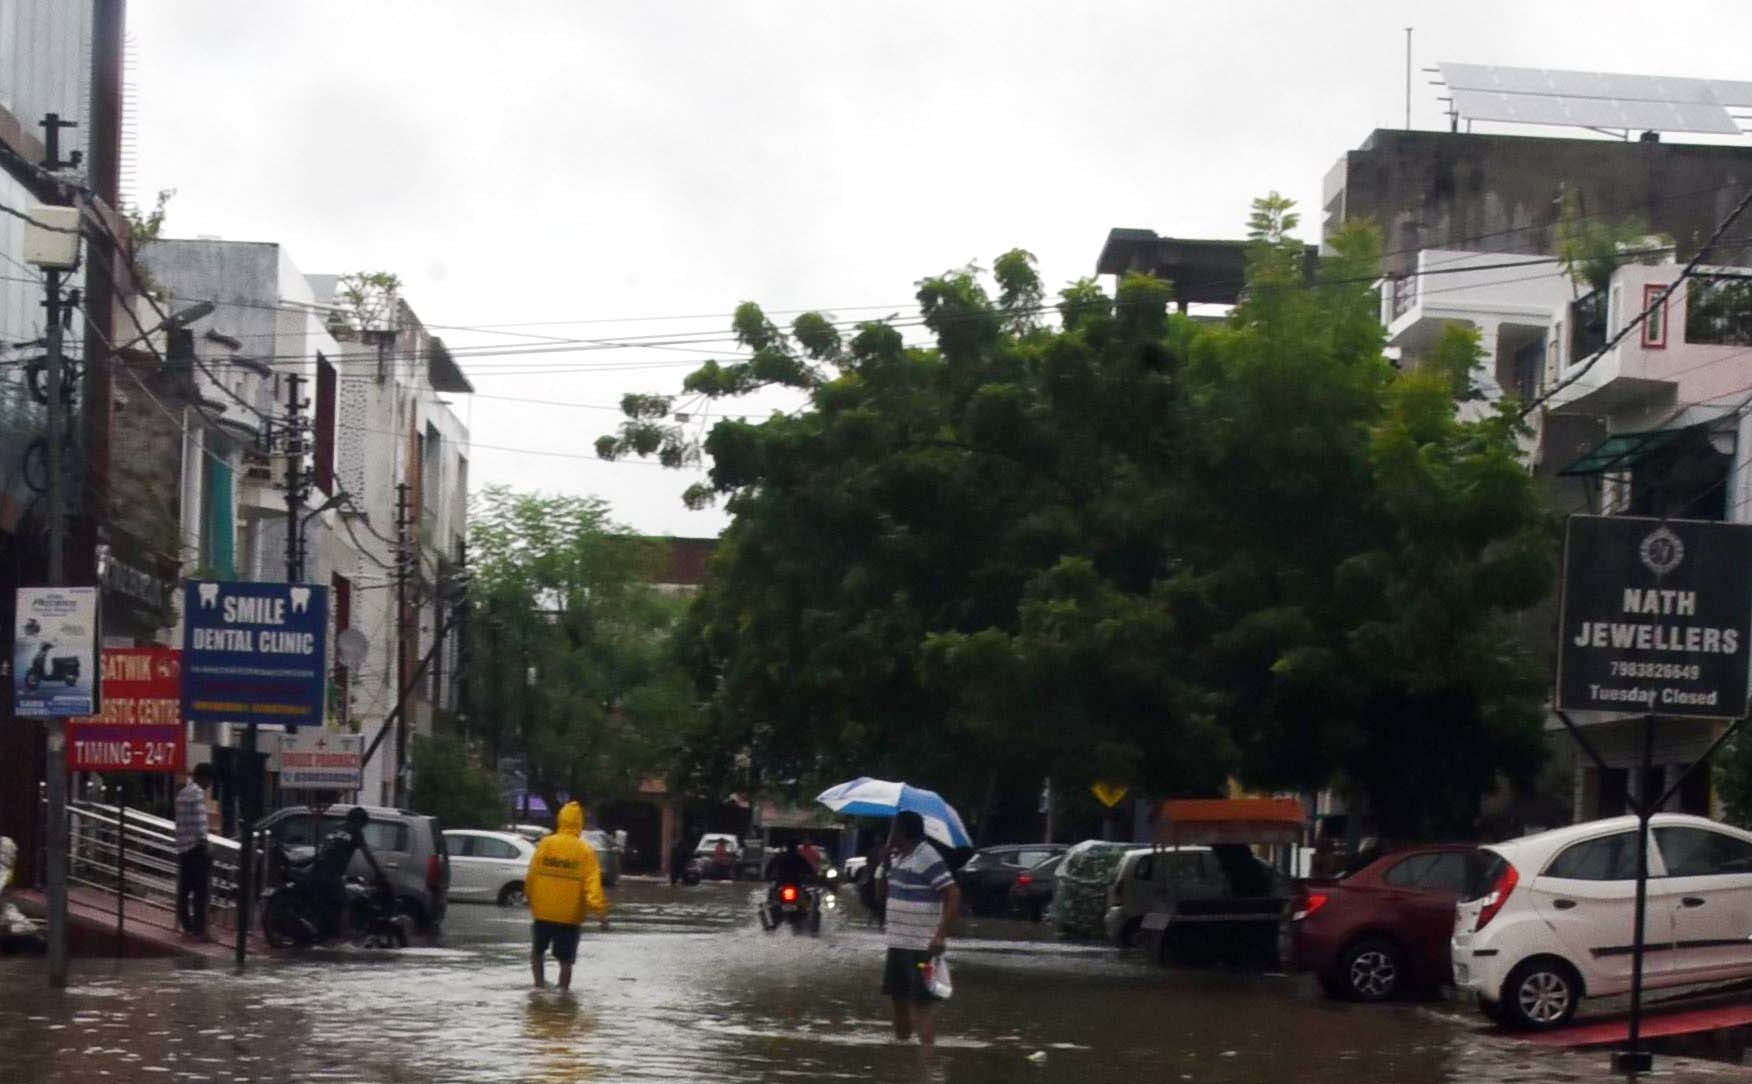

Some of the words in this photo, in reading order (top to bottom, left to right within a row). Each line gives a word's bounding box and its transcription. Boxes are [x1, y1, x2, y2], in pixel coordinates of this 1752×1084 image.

[223, 595, 285, 625] SMILE
[1623, 588, 1696, 616] NATH
[193, 628, 253, 652] DENTAL
[259, 631, 314, 655] CLINIC
[1574, 622, 1739, 654] JEWELLERS
[1590, 684, 1658, 708] Tuesday
[1661, 688, 1718, 706] Closed
[137, 697, 181, 725] CENTRE
